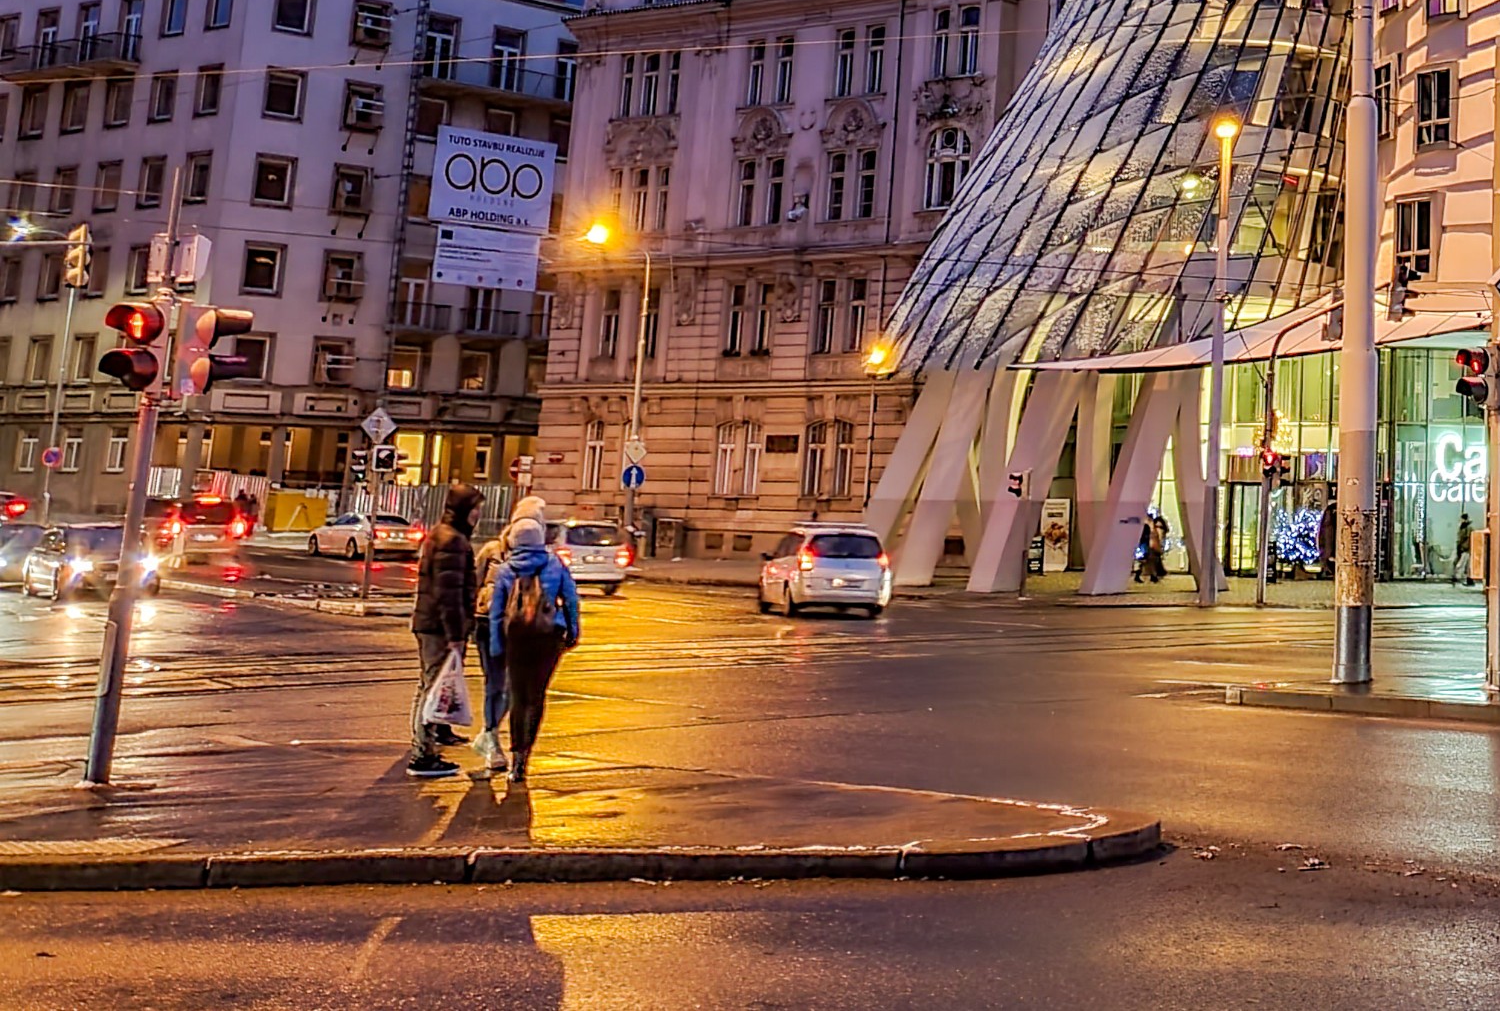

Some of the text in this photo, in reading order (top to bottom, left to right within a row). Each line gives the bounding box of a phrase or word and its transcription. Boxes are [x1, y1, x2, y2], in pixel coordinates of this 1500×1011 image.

[449, 135, 545, 158] TUTO STAVBU REALIZUJE
[469, 195, 514, 207] HOLDING
[448, 207, 468, 217] ABP
[470, 210, 514, 224] HOLDING
